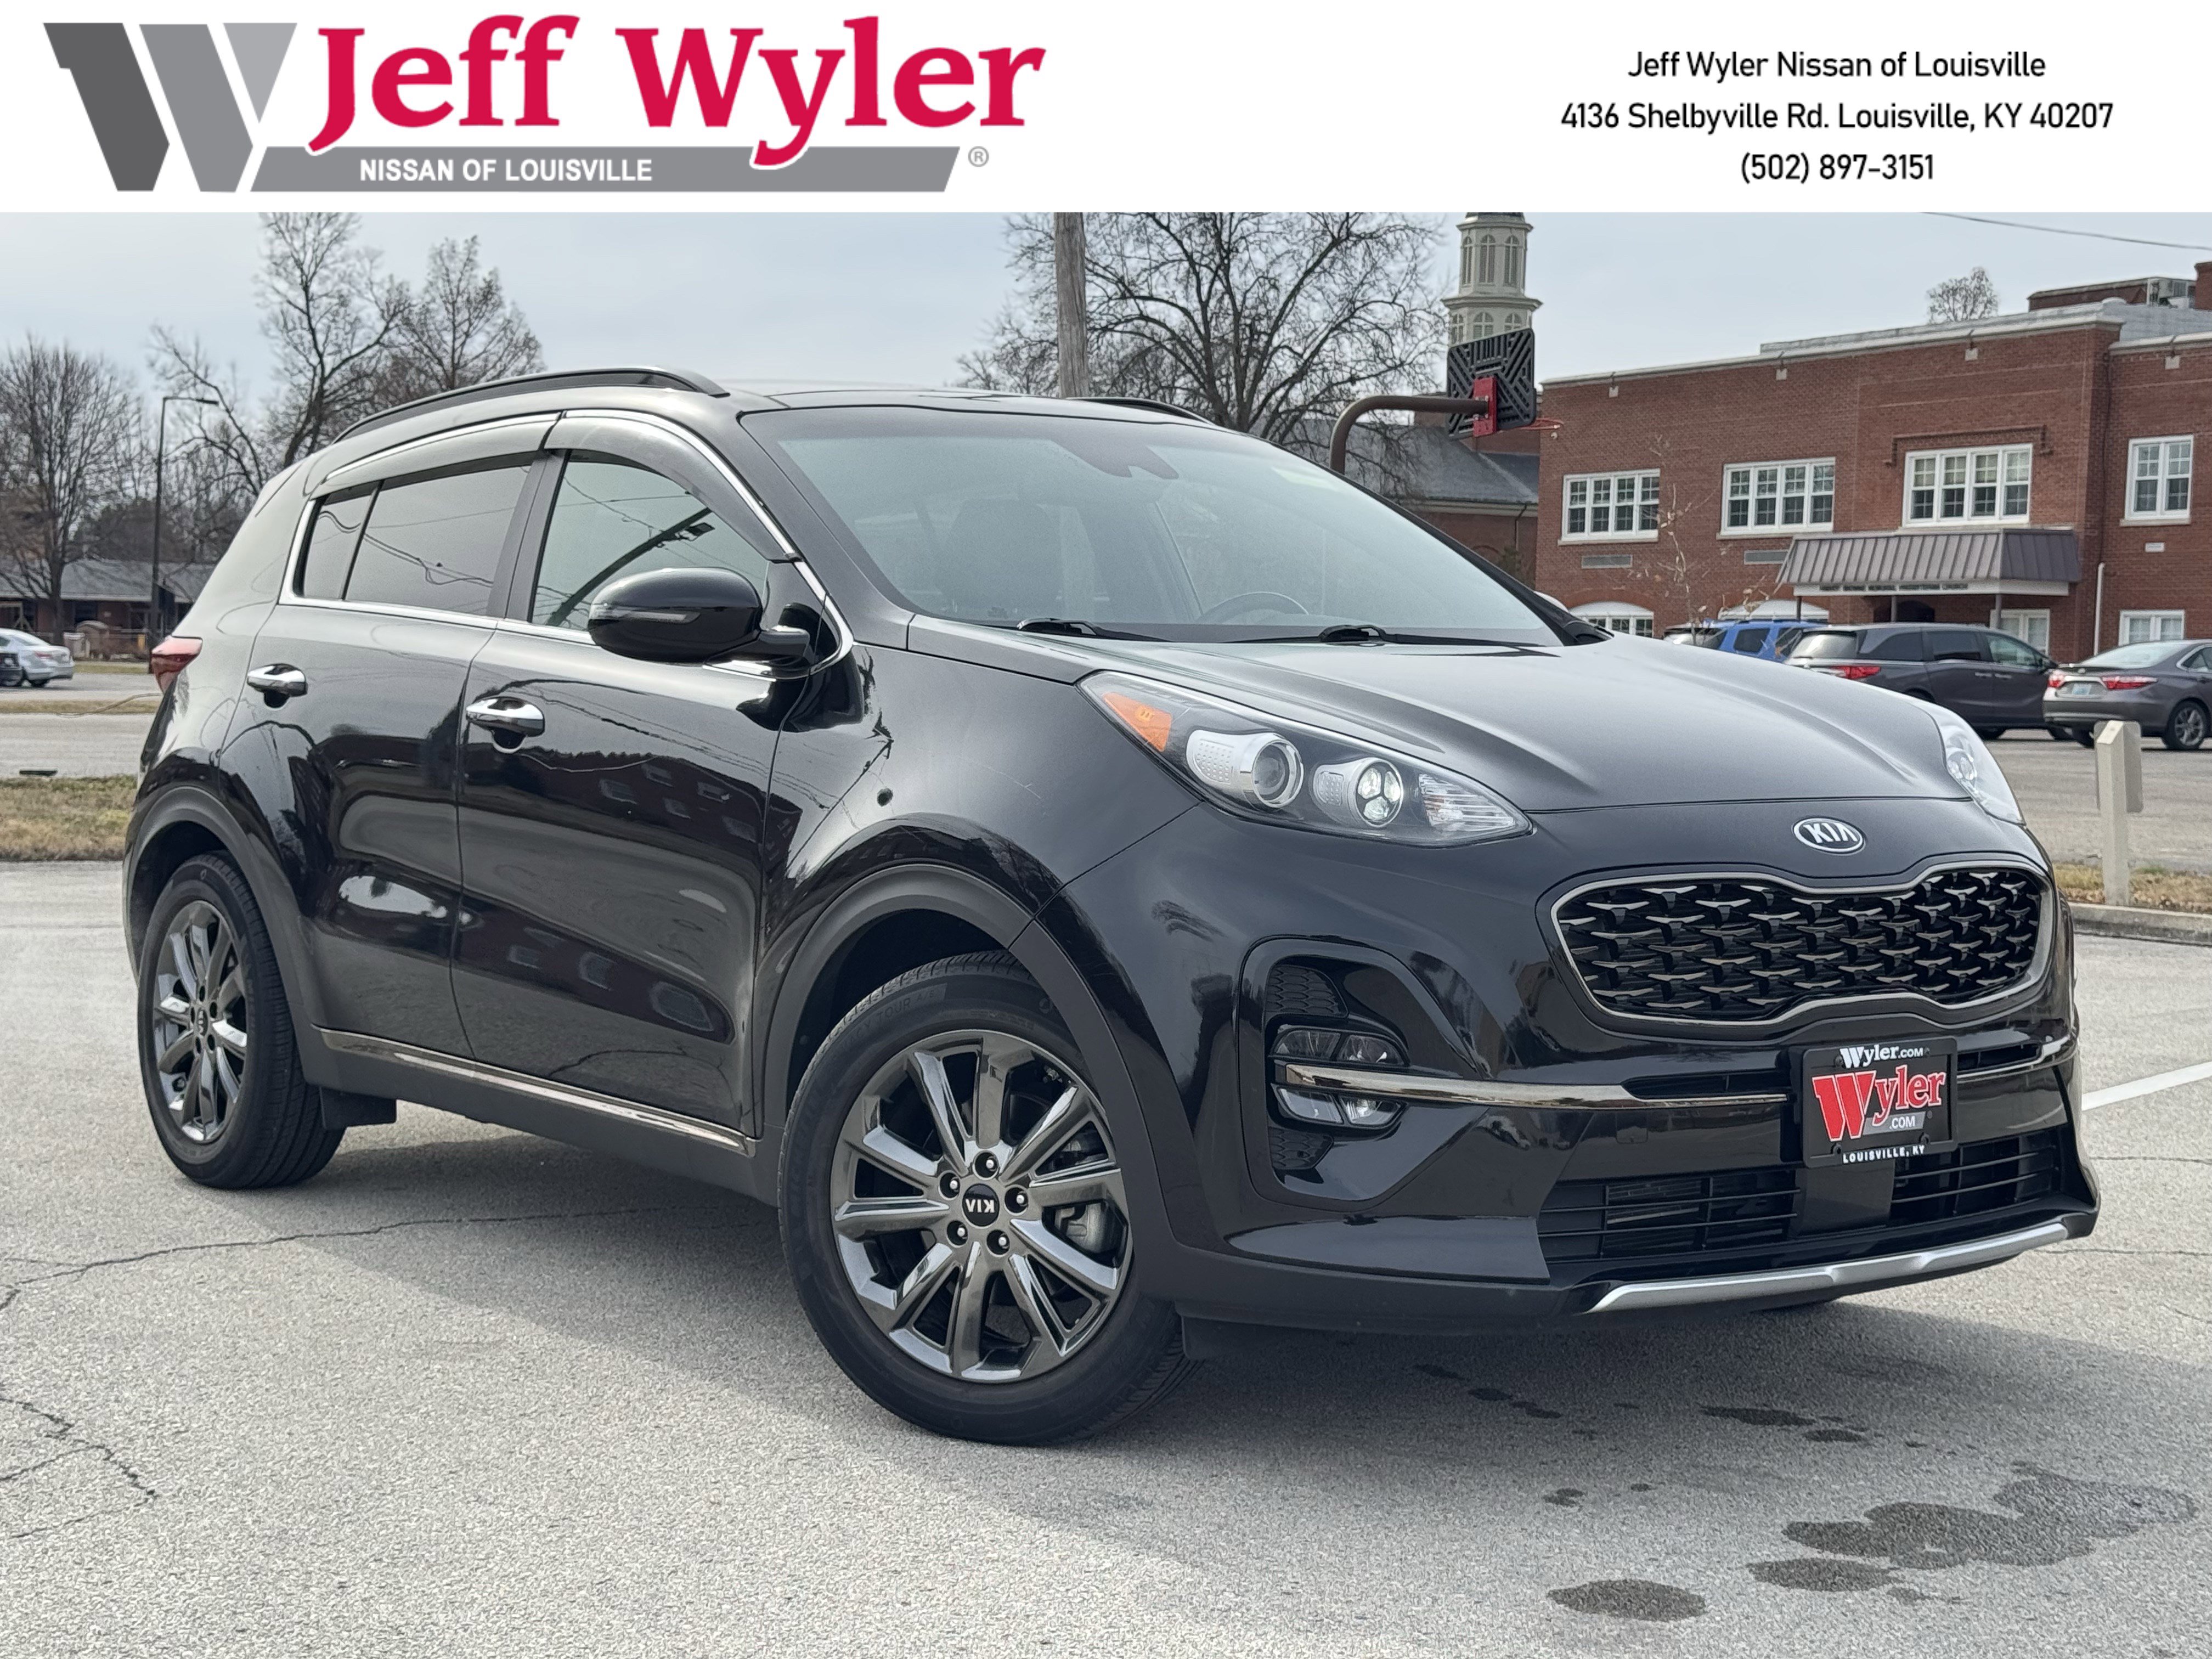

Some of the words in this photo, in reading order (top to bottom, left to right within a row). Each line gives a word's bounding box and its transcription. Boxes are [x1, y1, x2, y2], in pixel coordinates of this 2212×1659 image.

[1803, 822, 1858, 843] KIA
[1812, 1064, 1947, 1142] Wyler
[1843, 1147, 1909, 1164] LOUISVILLE,
[1912, 1145, 1925, 1155] KY
[966, 1199, 995, 1213] KIA
